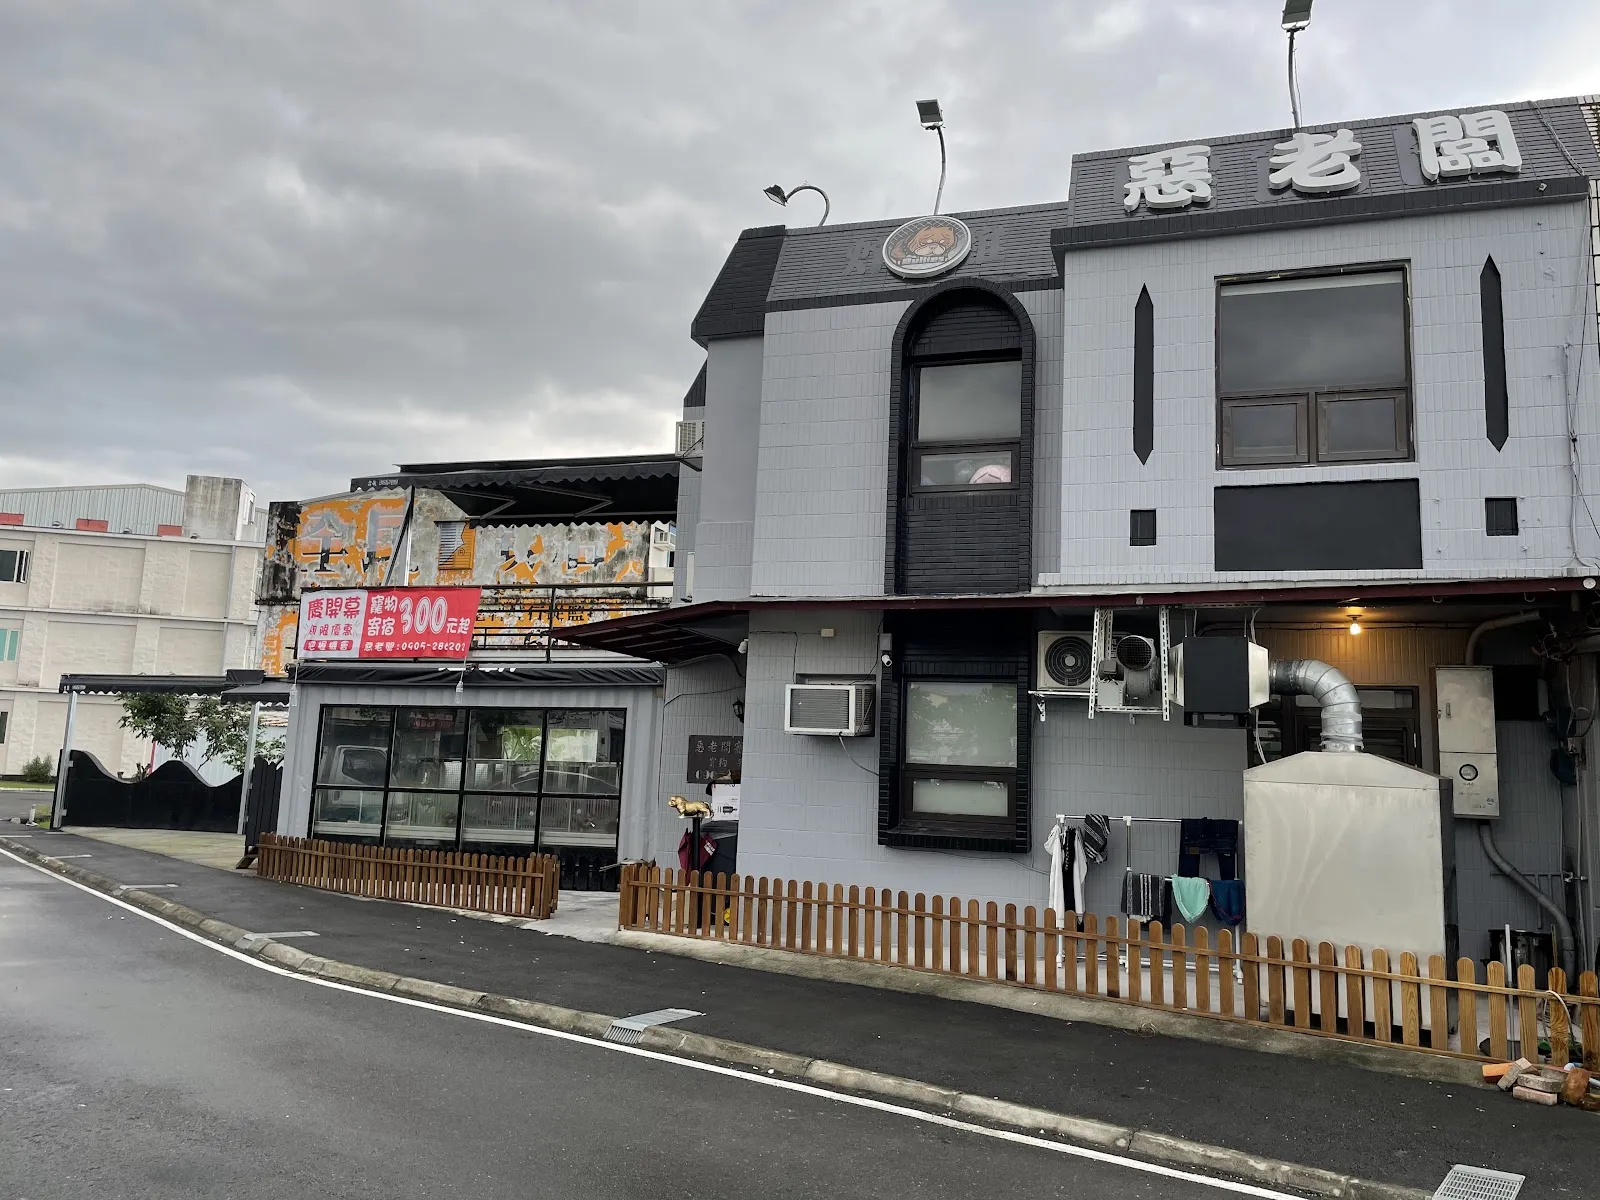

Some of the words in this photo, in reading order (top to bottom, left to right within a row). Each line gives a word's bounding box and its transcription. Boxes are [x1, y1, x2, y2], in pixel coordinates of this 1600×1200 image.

[307, 596, 361, 621] 慶開幕
[370, 594, 398, 614] 寵物
[399, 596, 448, 635] 300
[446, 617, 471, 635] 元起
[367, 616, 396, 637] 寄宿
